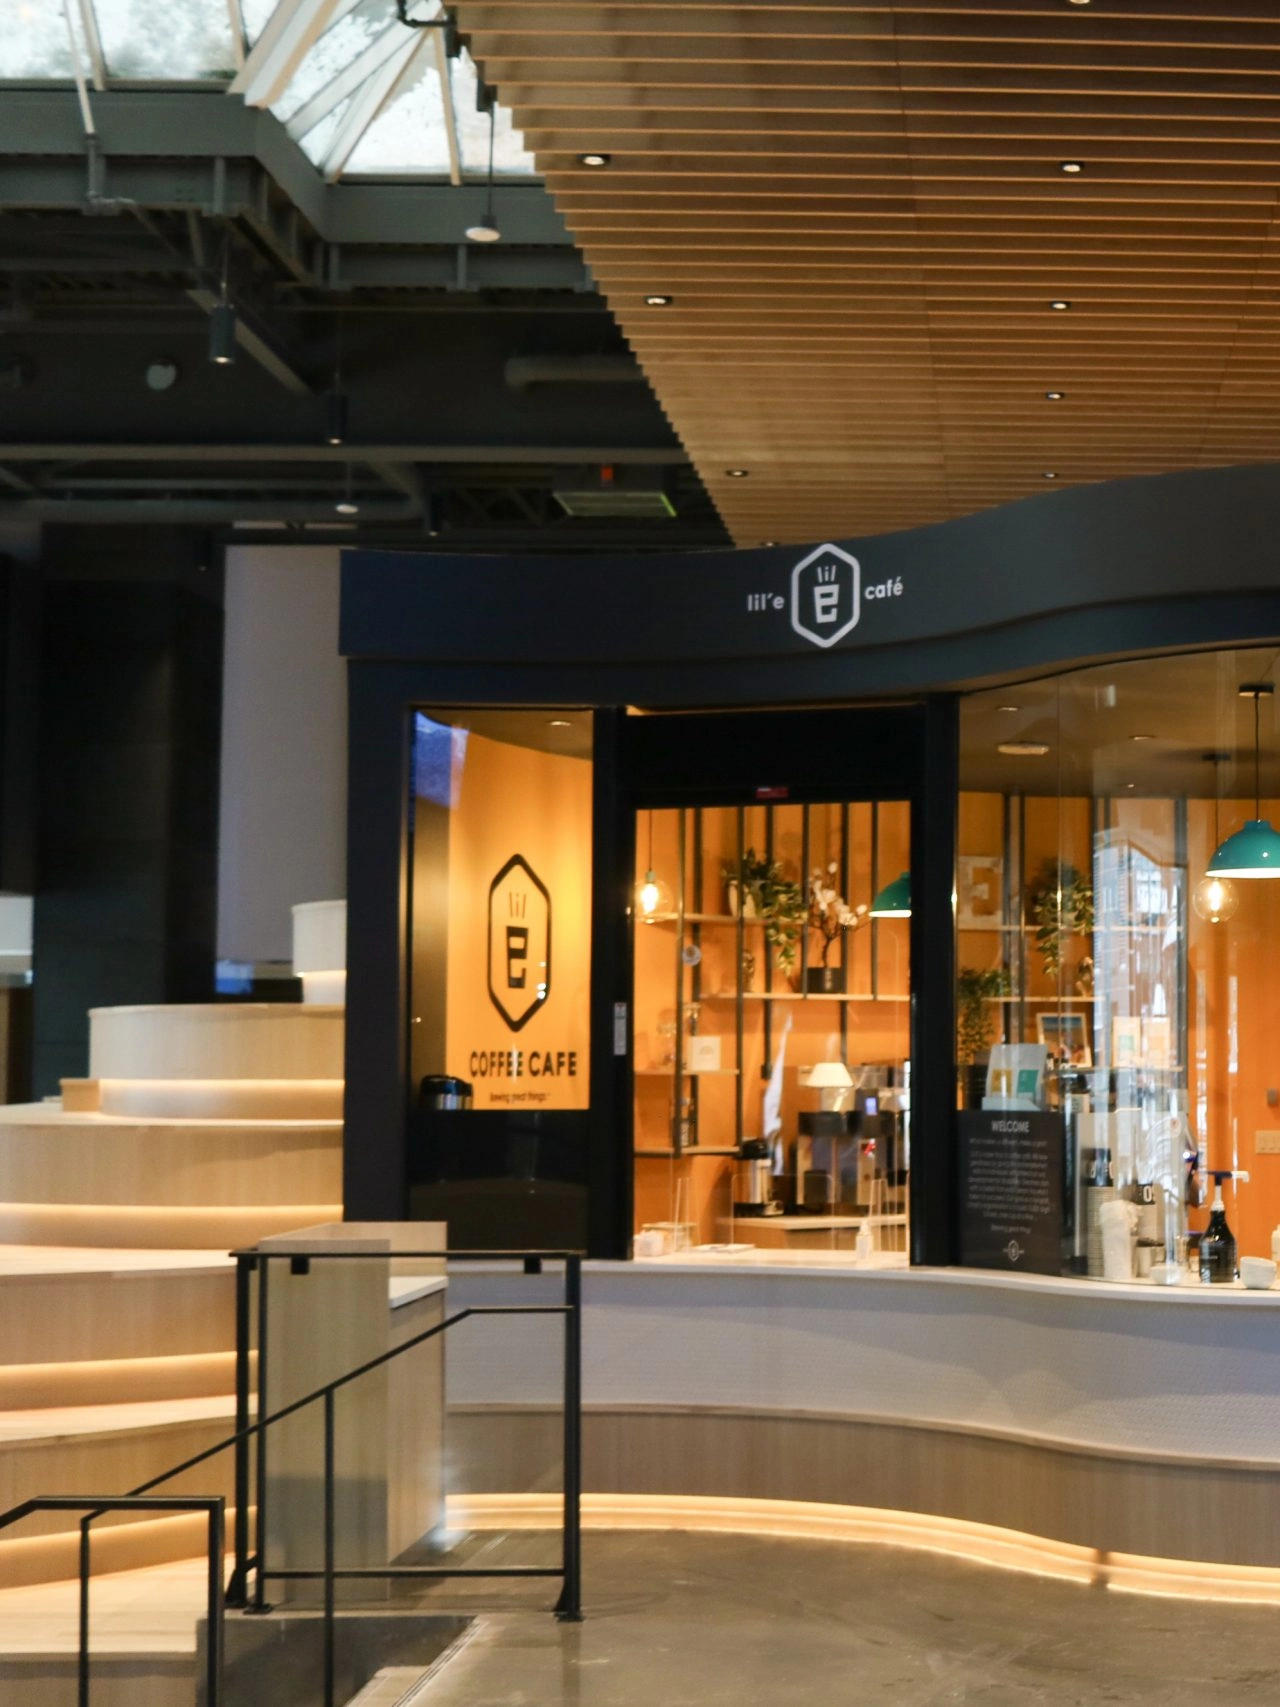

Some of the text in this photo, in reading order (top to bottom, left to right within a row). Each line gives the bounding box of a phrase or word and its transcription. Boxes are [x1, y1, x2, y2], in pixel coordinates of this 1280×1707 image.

[865, 576, 903, 601] café
[470, 1050, 577, 1077] COFFEE CAFE
[991, 1120, 1030, 1133] WELCOME
